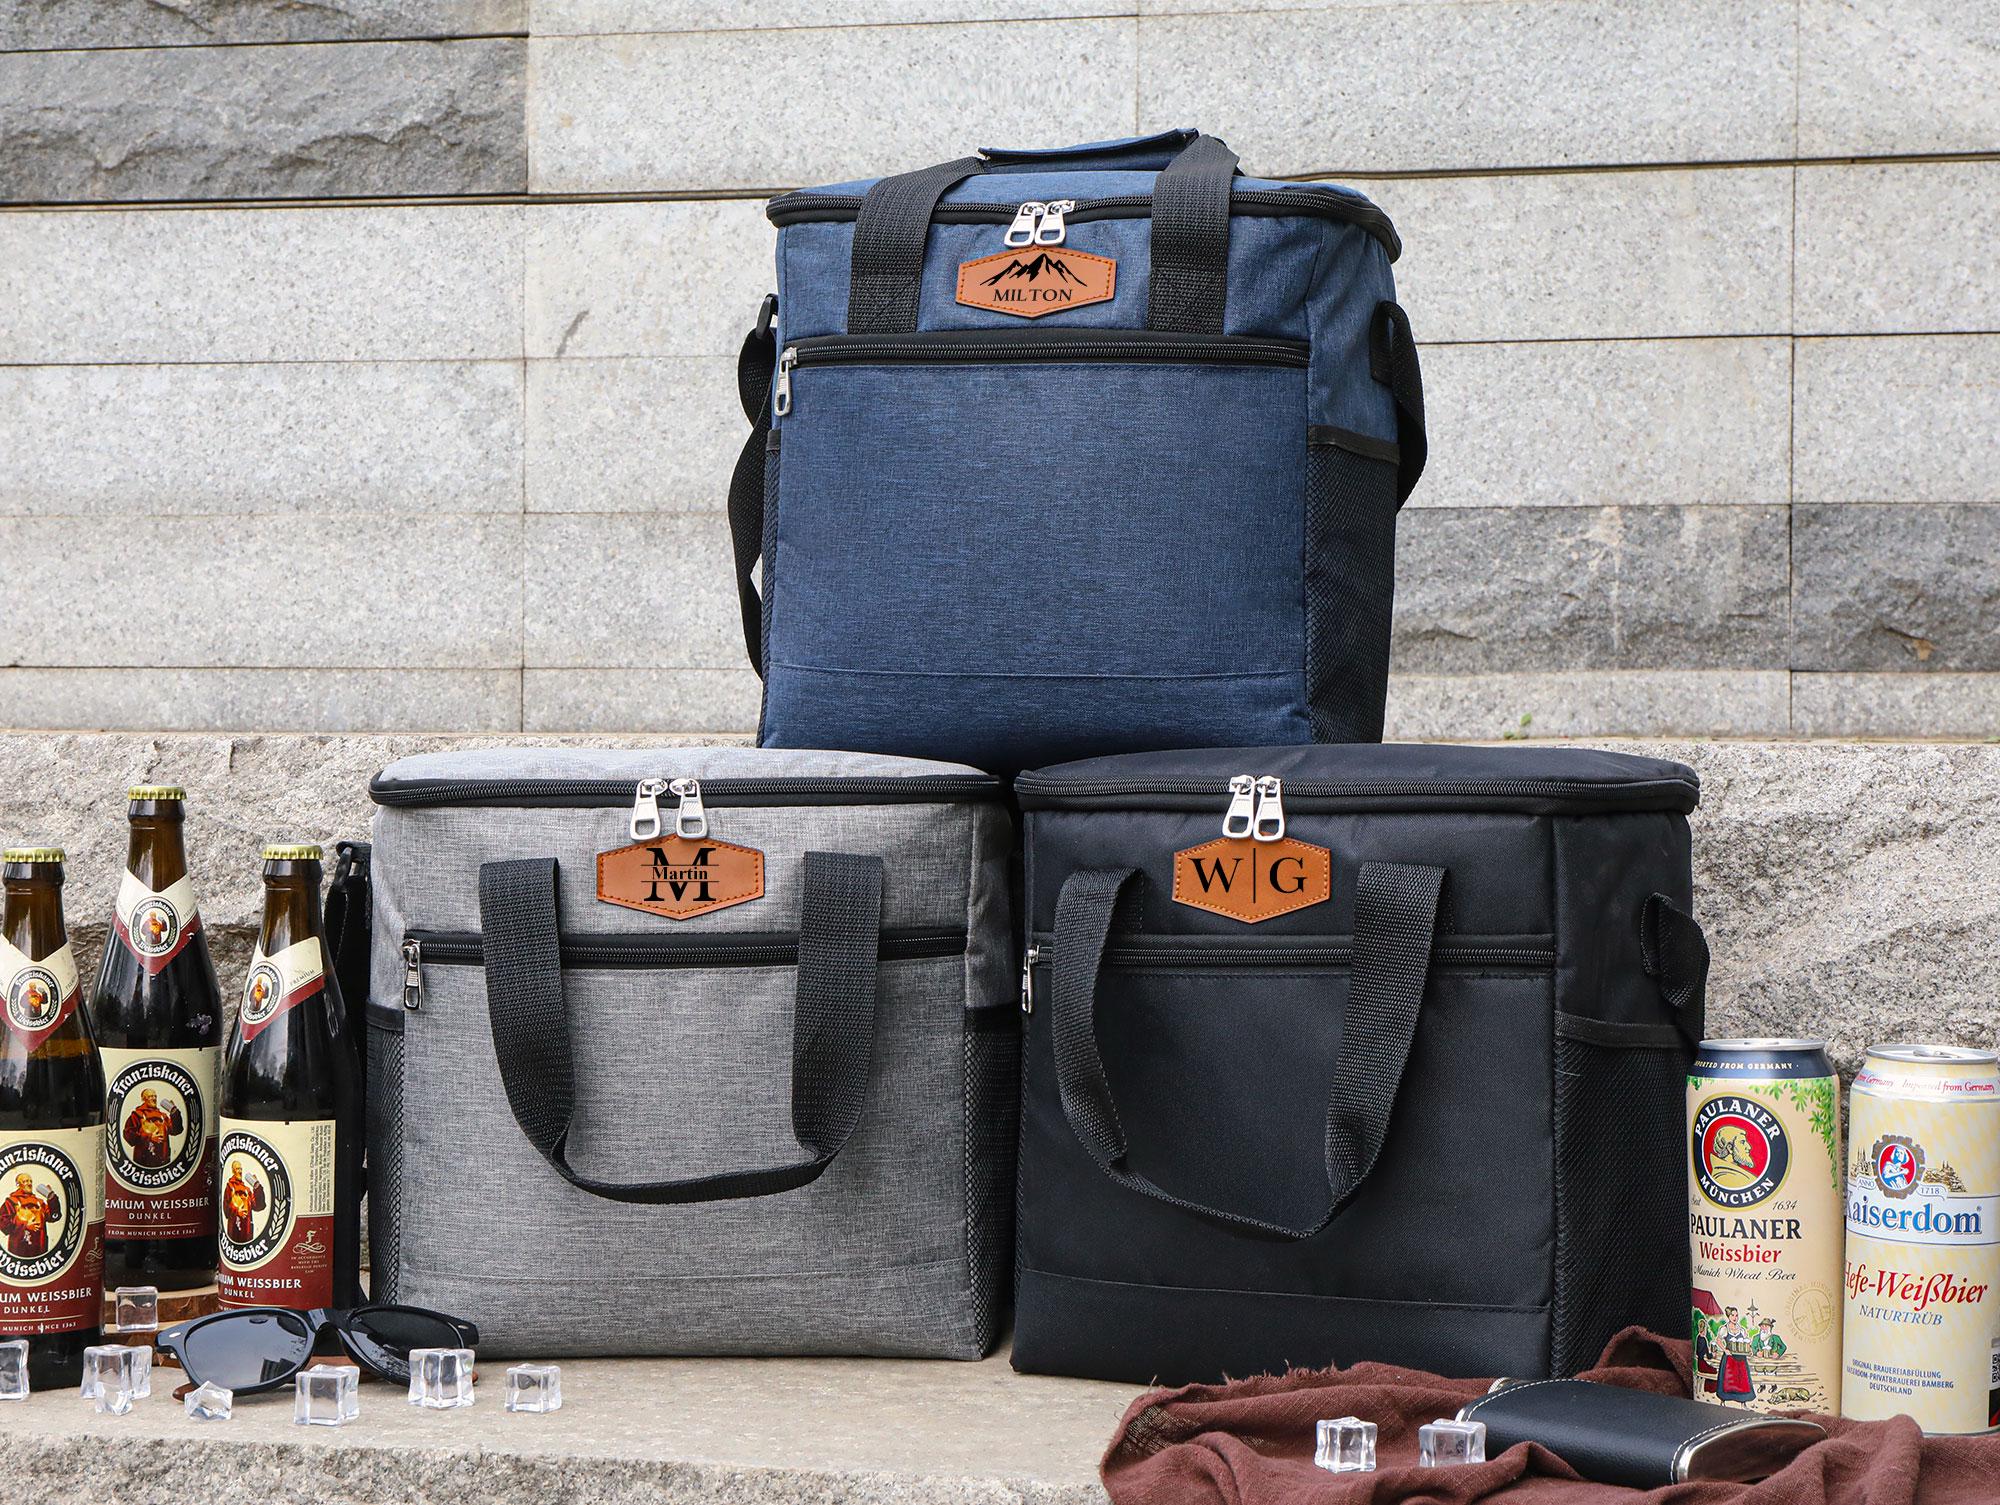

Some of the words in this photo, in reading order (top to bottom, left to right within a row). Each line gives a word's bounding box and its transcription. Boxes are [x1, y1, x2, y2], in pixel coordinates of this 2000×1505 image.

[993, 289, 1073, 302] MILTON
[643, 848, 717, 901] M
[652, 867, 709, 880] Martin
[1187, 857, 1244, 893] W
[1269, 857, 1307, 894] G
[1719, 1062, 1744, 1070] FROM
[1747, 1062, 1793, 1070] GERMANY
[112, 1064, 195, 1099] Franziskaner
[1942, 1081, 1962, 1095] from
[1695, 1099, 1781, 1140] PAULANER
[0, 1147, 74, 1181] anziskaner
[119, 1159, 186, 1186] Weissbier
[1700, 1175, 1775, 1204] MÜNCHEN
[1859, 1178, 1874, 1188] ANNO
[1920, 1187, 1940, 1195] 1718
[105, 1198, 145, 1210] EMIUM
[150, 1196, 210, 1210] WEISSBIER
[1772, 1200, 1798, 1211] 1634
[128, 1212, 172, 1220] DUNKEL
[1690, 1213, 1802, 1240] PAULANER
[220, 1232, 269, 1262] Weissbier
[1699, 1241, 1782, 1263] Weissbier
[1694, 1264, 1721, 1279] Munich
[1725, 1267, 1762, 1280] Wheat
[1766, 1268, 1797, 1281] Beer
[237, 1276, 302, 1289] WEISSBIER
[27, 1286, 92, 1303] WEISSBIER
[224, 1287, 255, 1299] DUNKEL
[4, 1305, 50, 1314] DUNKEL
[1859, 1305, 1943, 1326] NATURTRÜB
[1869, 1382, 1913, 1395] DEUTSCHLAND
[1921, 1380, 1954, 1389] BAMBERG
